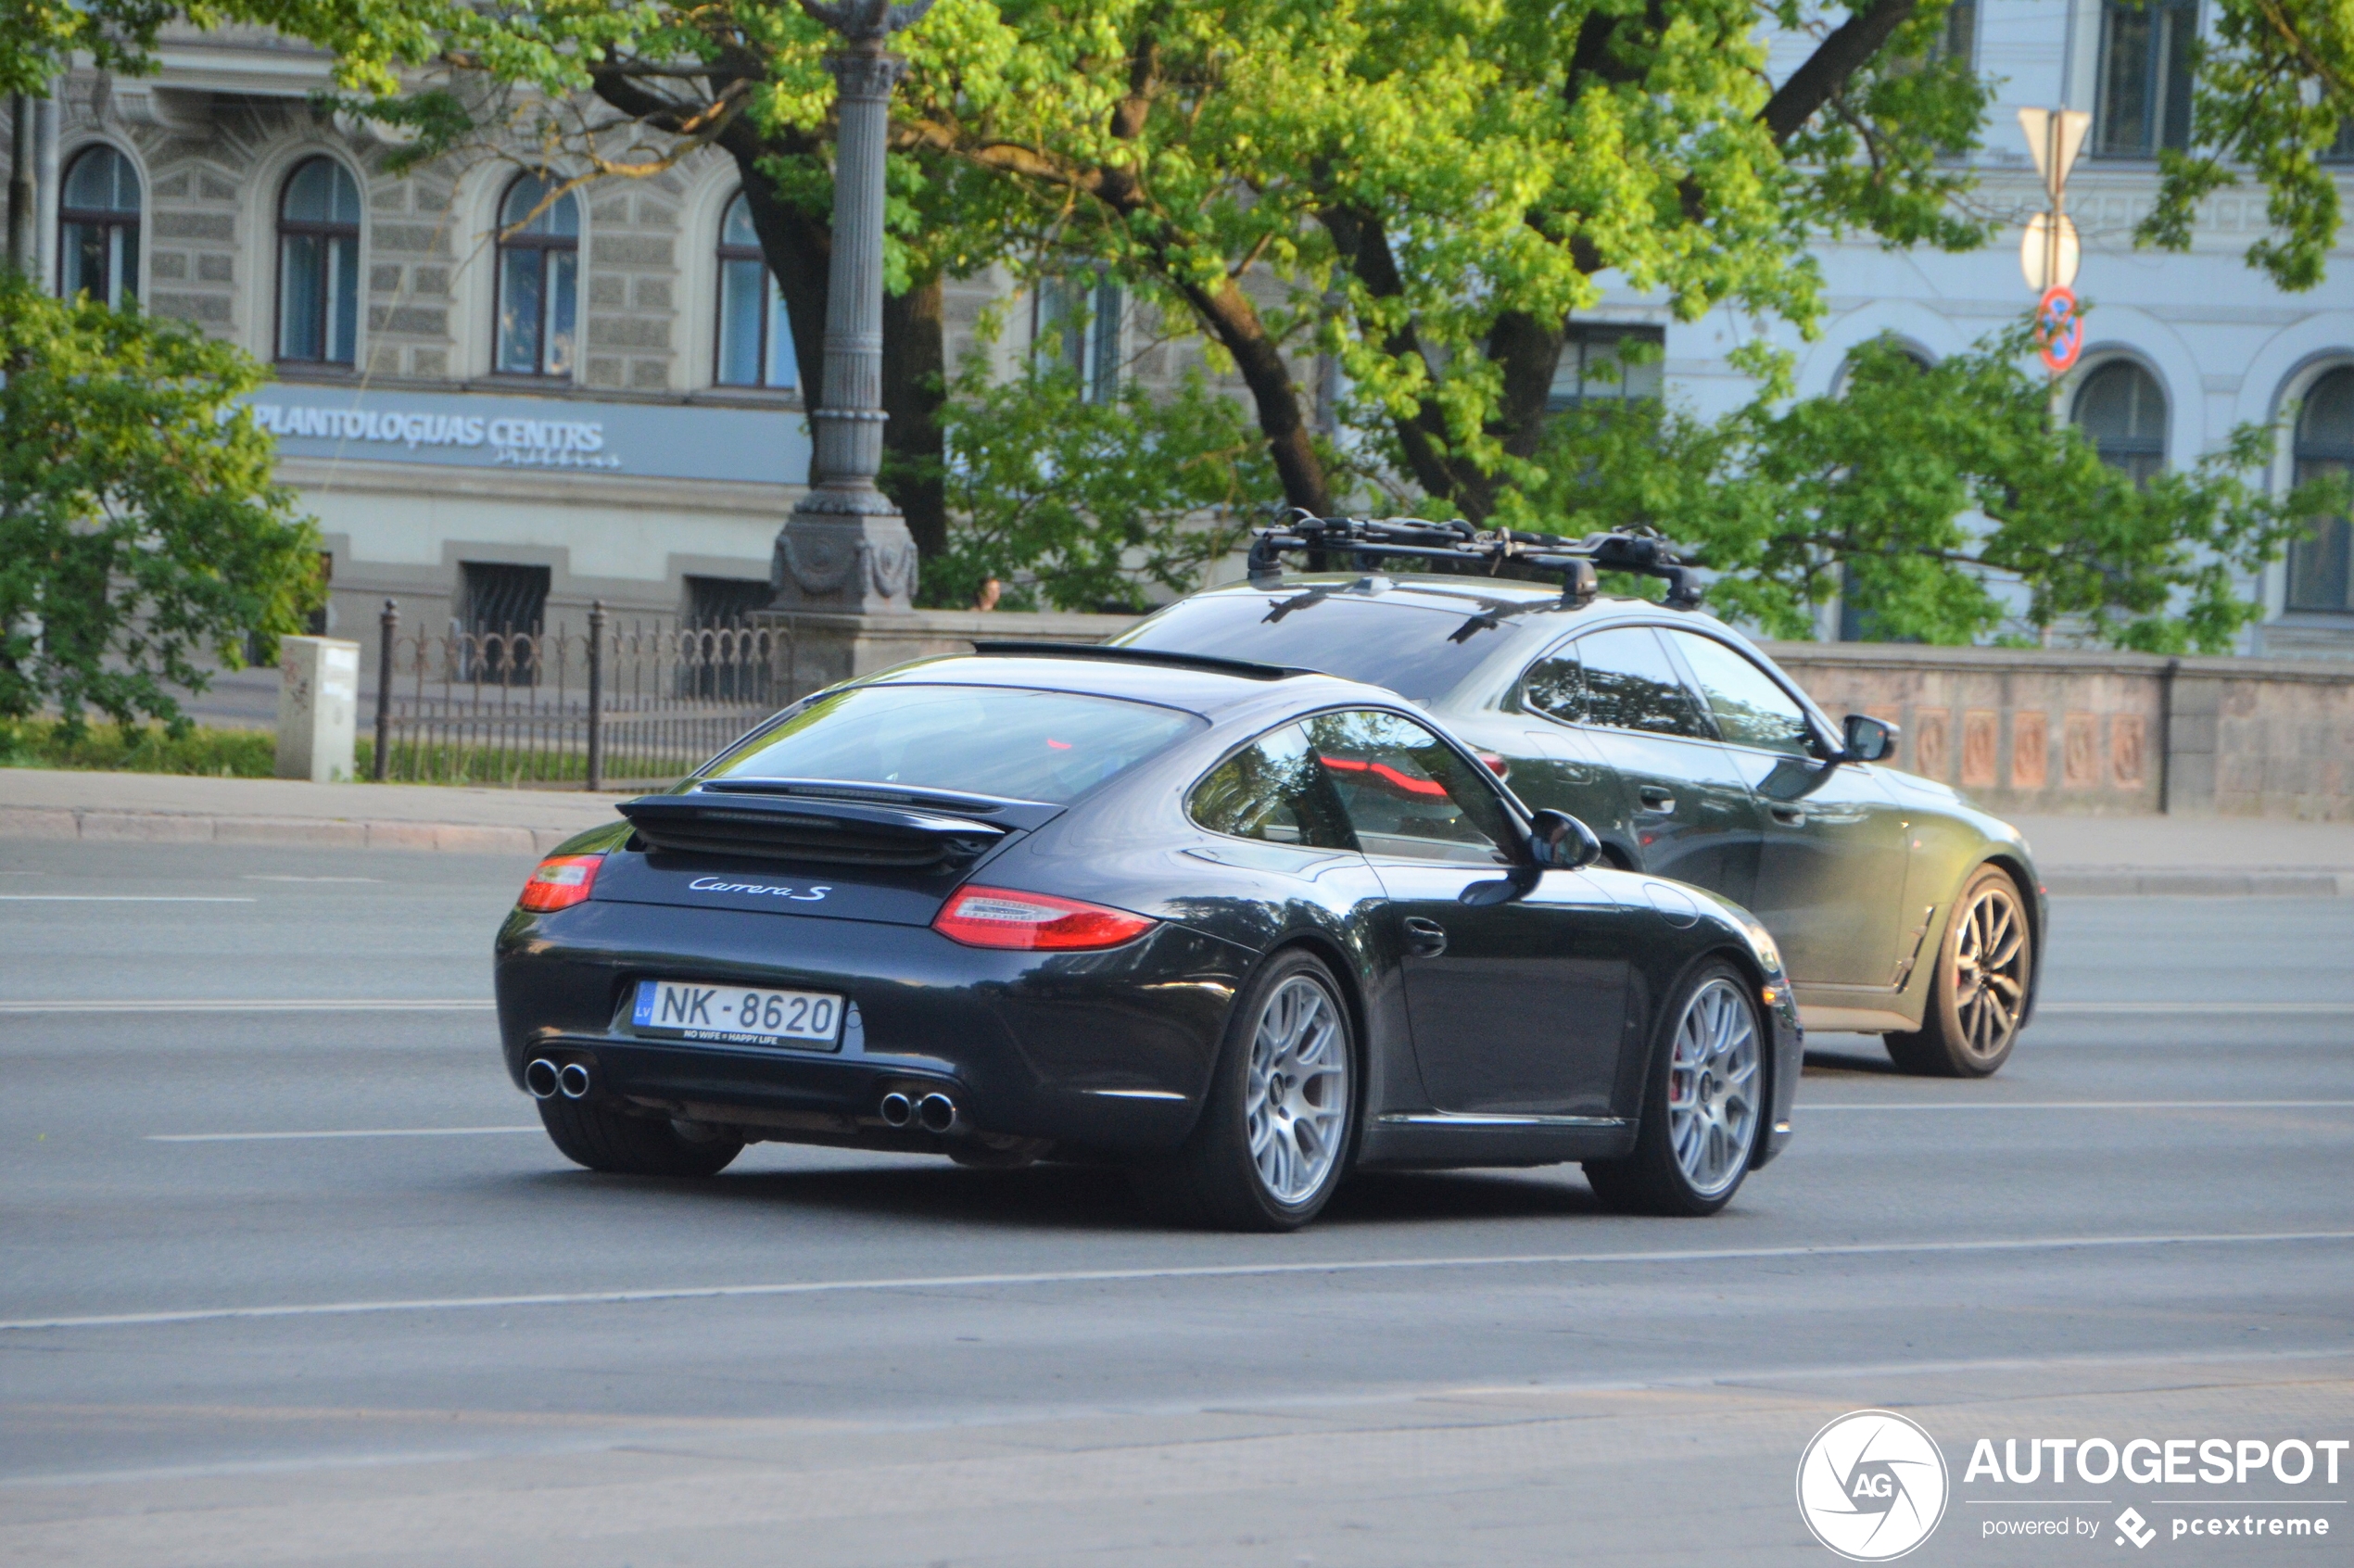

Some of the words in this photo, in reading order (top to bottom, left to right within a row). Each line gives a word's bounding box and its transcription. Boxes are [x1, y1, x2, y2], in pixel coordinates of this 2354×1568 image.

[487, 419, 603, 451] CENTRS
[690, 877, 791, 896] Carrera
[791, 887, 831, 901] S
[636, 1006, 651, 1018] LV
[684, 1030, 698, 1038] NO
[699, 1031, 721, 1041] WIFE
[728, 1033, 758, 1043] HAPPY
[758, 1036, 778, 1045] LIFE
